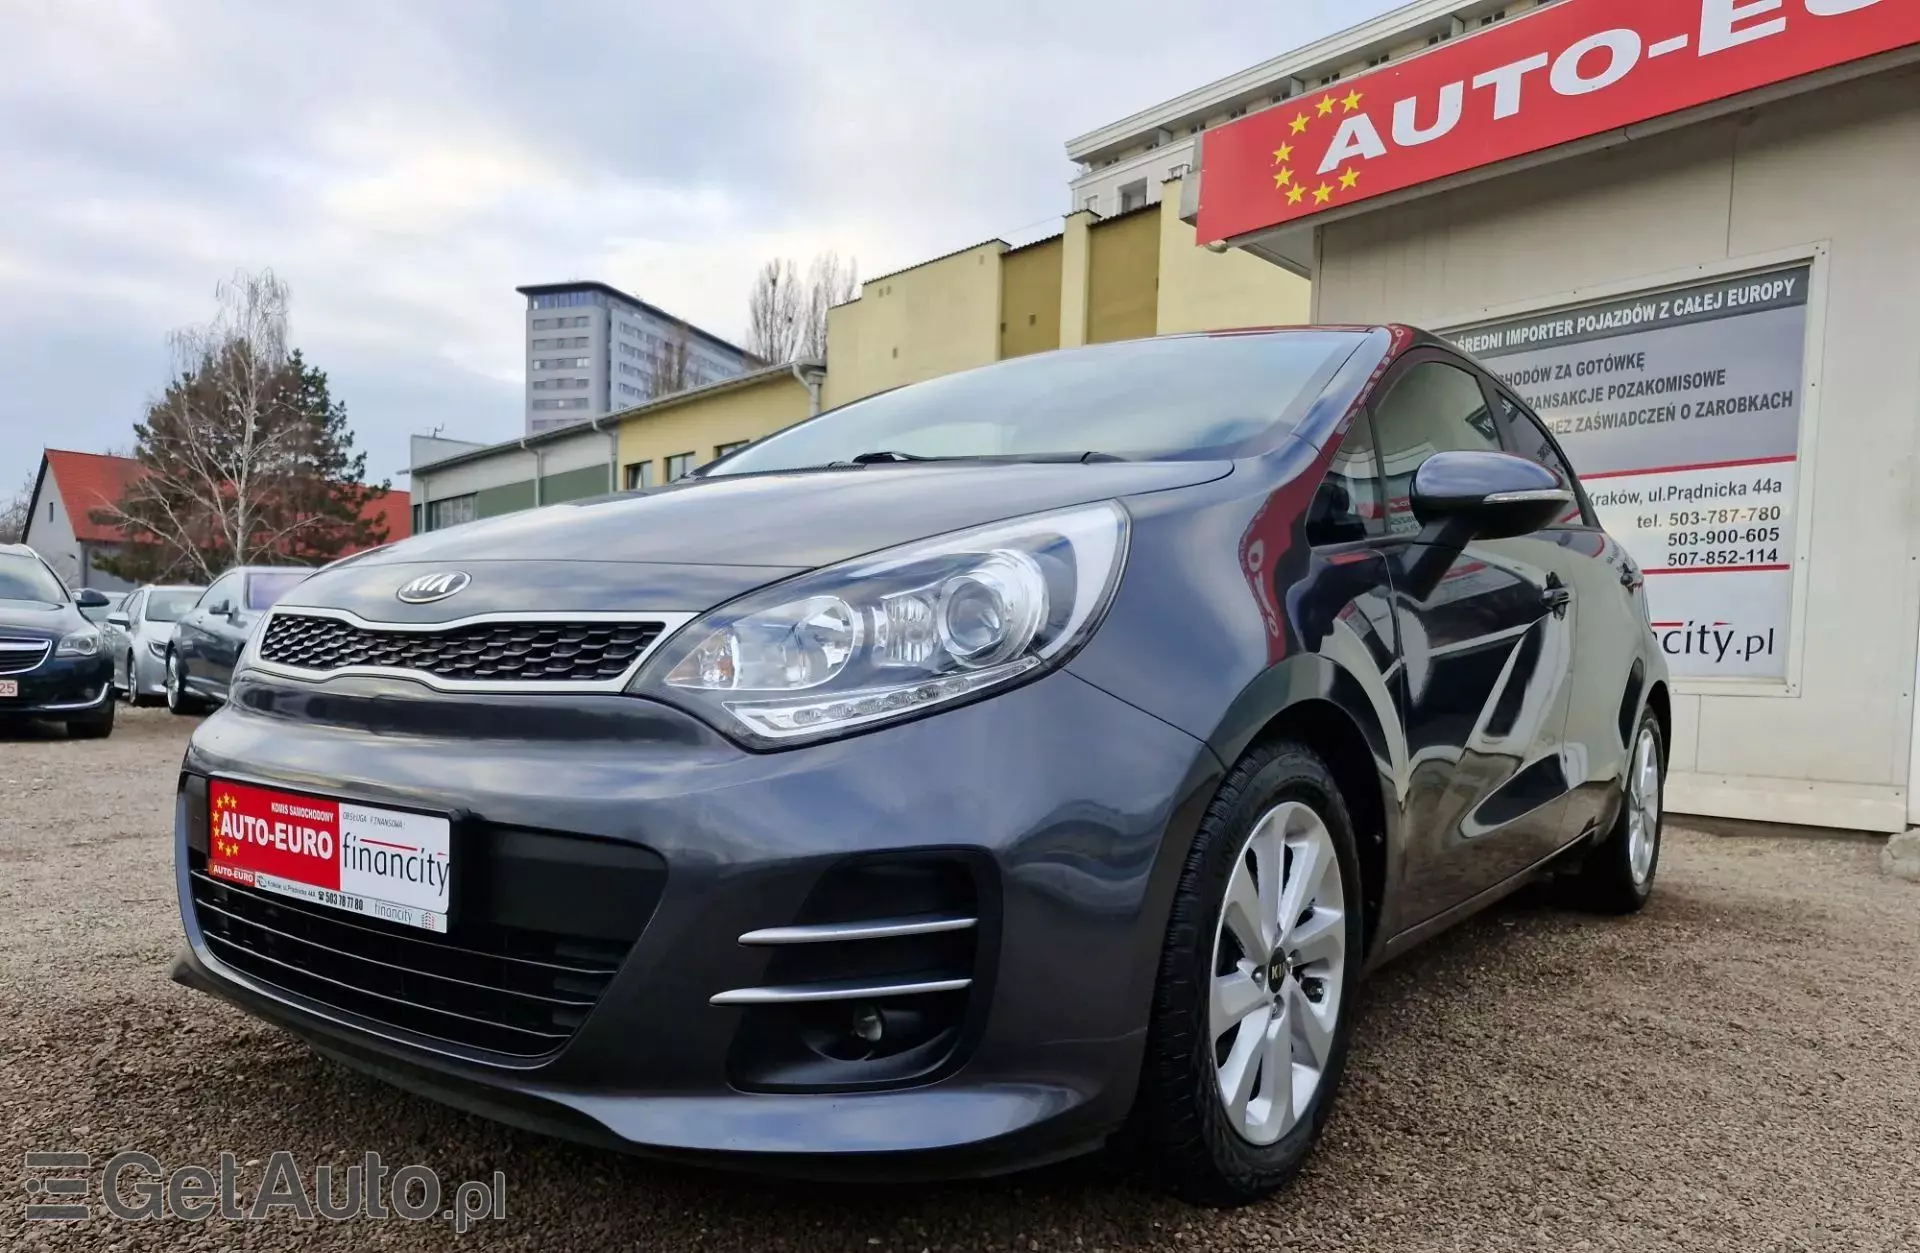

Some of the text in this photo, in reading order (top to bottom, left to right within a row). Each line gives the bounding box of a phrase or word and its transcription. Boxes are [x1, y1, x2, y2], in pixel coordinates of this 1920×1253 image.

[1316, 0, 1882, 174] AUTO-E
[1506, 319, 1573, 346] IMPORTER
[1577, 303, 1656, 333] POJAZDÓW
[1659, 301, 1670, 319] Z
[1674, 291, 1723, 316] CAŁEJ
[1727, 278, 1796, 307] EUROPY
[1554, 363, 1572, 380] ZA
[1576, 351, 1646, 377] GOTÓWKĘ
[1607, 369, 1726, 401] POZAKOMISOWE
[1575, 404, 1676, 432] ZAŚWIADCZEŃ
[1680, 404, 1691, 419] O
[1695, 390, 1794, 418] ZAROBKACH
[1752, 478, 1782, 494] 44a
[1637, 505, 1781, 529] tel. 503-787-780
[1667, 527, 1780, 546] 503-900-605
[1667, 548, 1778, 566] 507-852-114
[1652, 620, 1774, 662] city.pl
[220, 811, 333, 860] AUTO-EURO
[213, 864, 254, 883] AUTO-EURO
[342, 832, 450, 896] financity
[325, 891, 338, 905] 503
[355, 898, 364, 911] 80
[374, 900, 413, 924] financity
